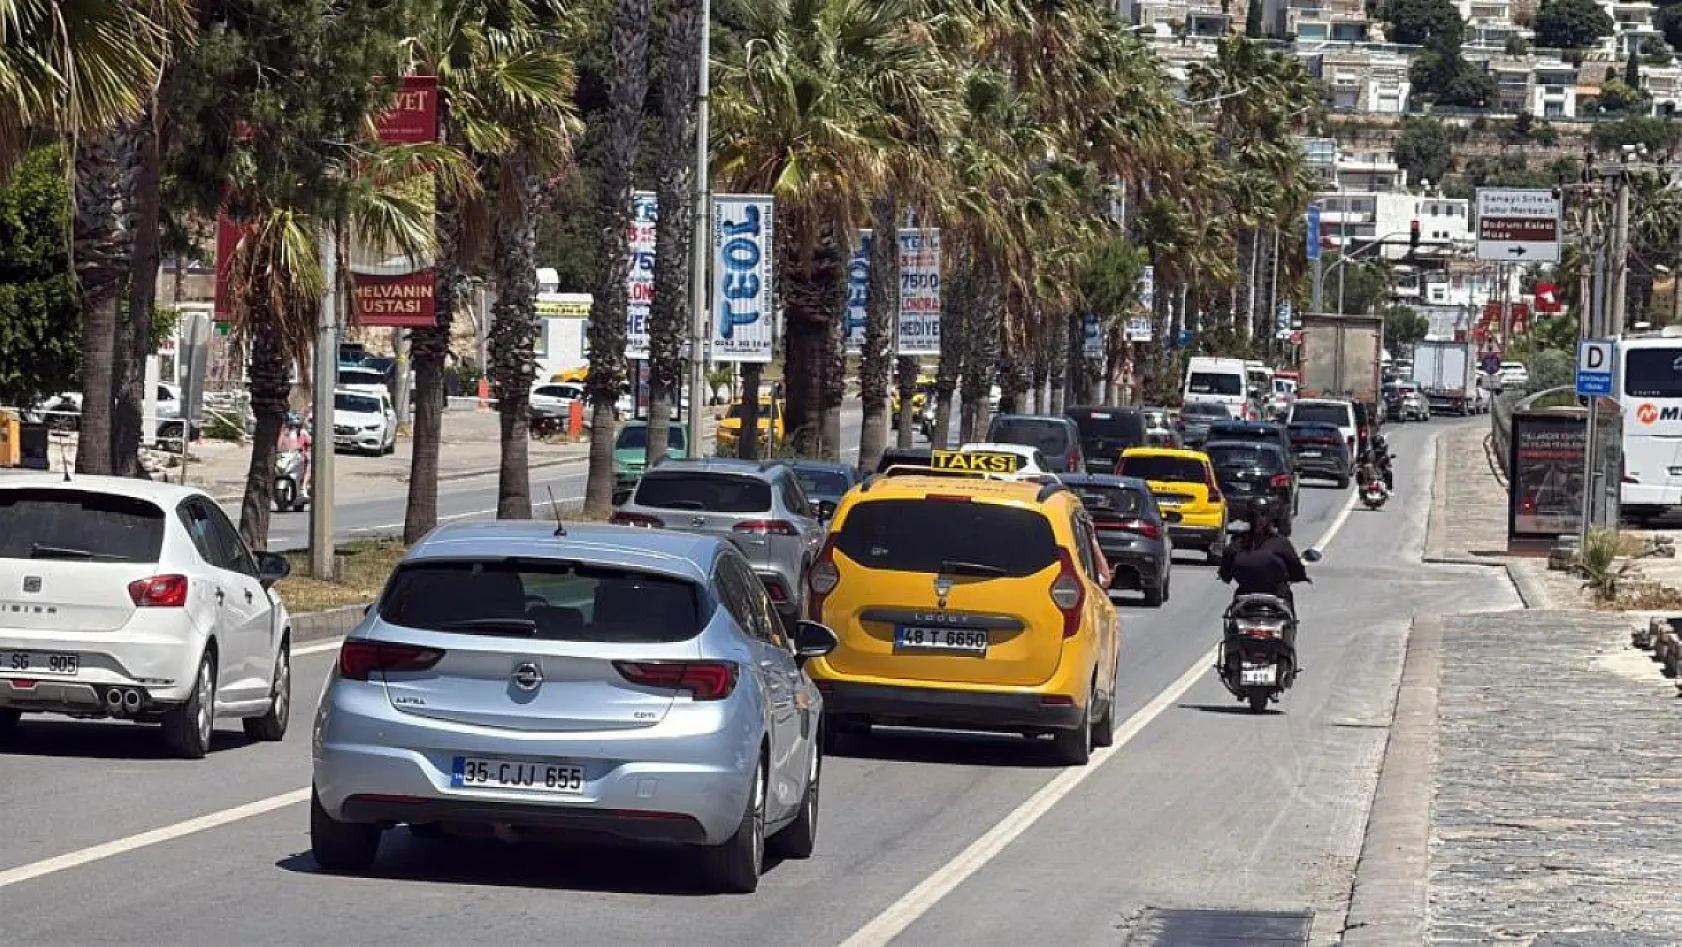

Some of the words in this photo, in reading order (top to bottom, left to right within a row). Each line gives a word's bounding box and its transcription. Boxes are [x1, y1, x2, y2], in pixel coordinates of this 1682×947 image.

[720, 204, 762, 339] TEOL
[364, 300, 421, 313] USTASI
[1588, 346, 1604, 367] D
[1660, 406, 1682, 420] M
[931, 631, 940, 646] T
[947, 632, 986, 648] 6650
[12, 653, 29, 669] SG
[49, 656, 77, 673] 905
[465, 761, 489, 782] 35
[500, 763, 536, 787] CJJ
[546, 766, 581, 789] 655
